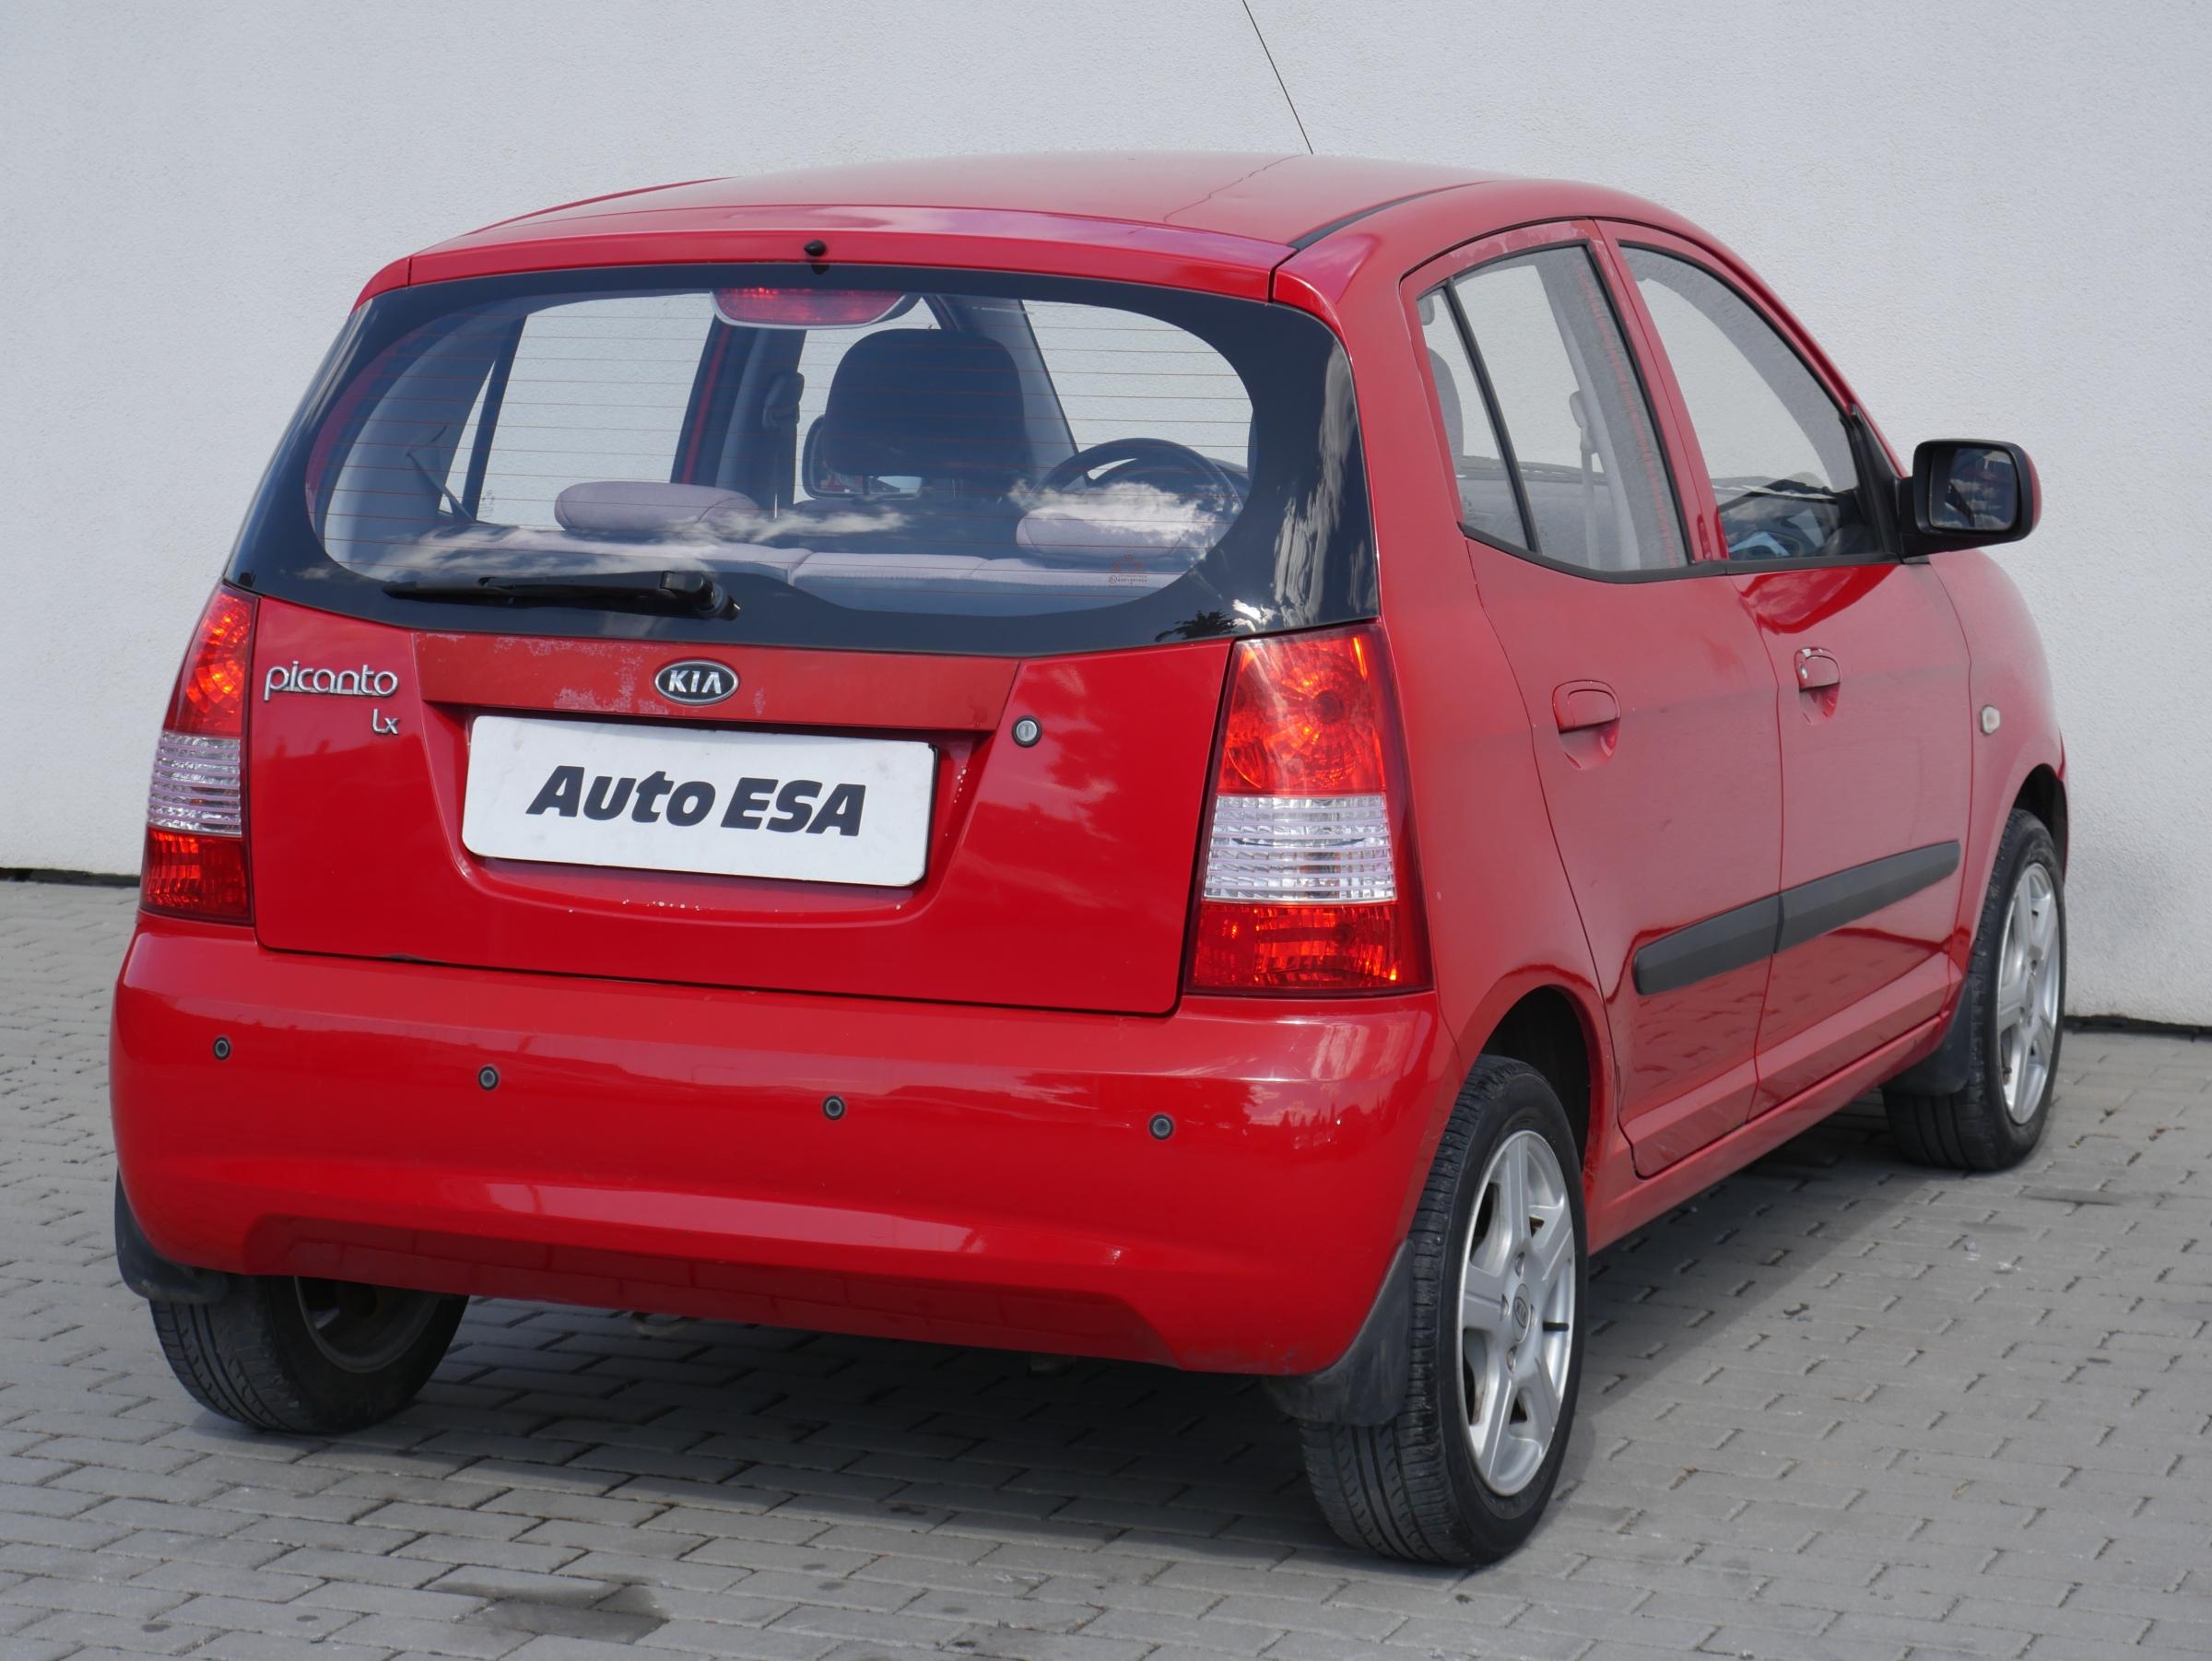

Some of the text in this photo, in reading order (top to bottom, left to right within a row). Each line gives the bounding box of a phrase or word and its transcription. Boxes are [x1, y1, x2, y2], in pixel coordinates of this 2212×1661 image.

[264, 660, 399, 701] picanto
[668, 669, 722, 694] KIA
[525, 765, 866, 837] Auto ESA
